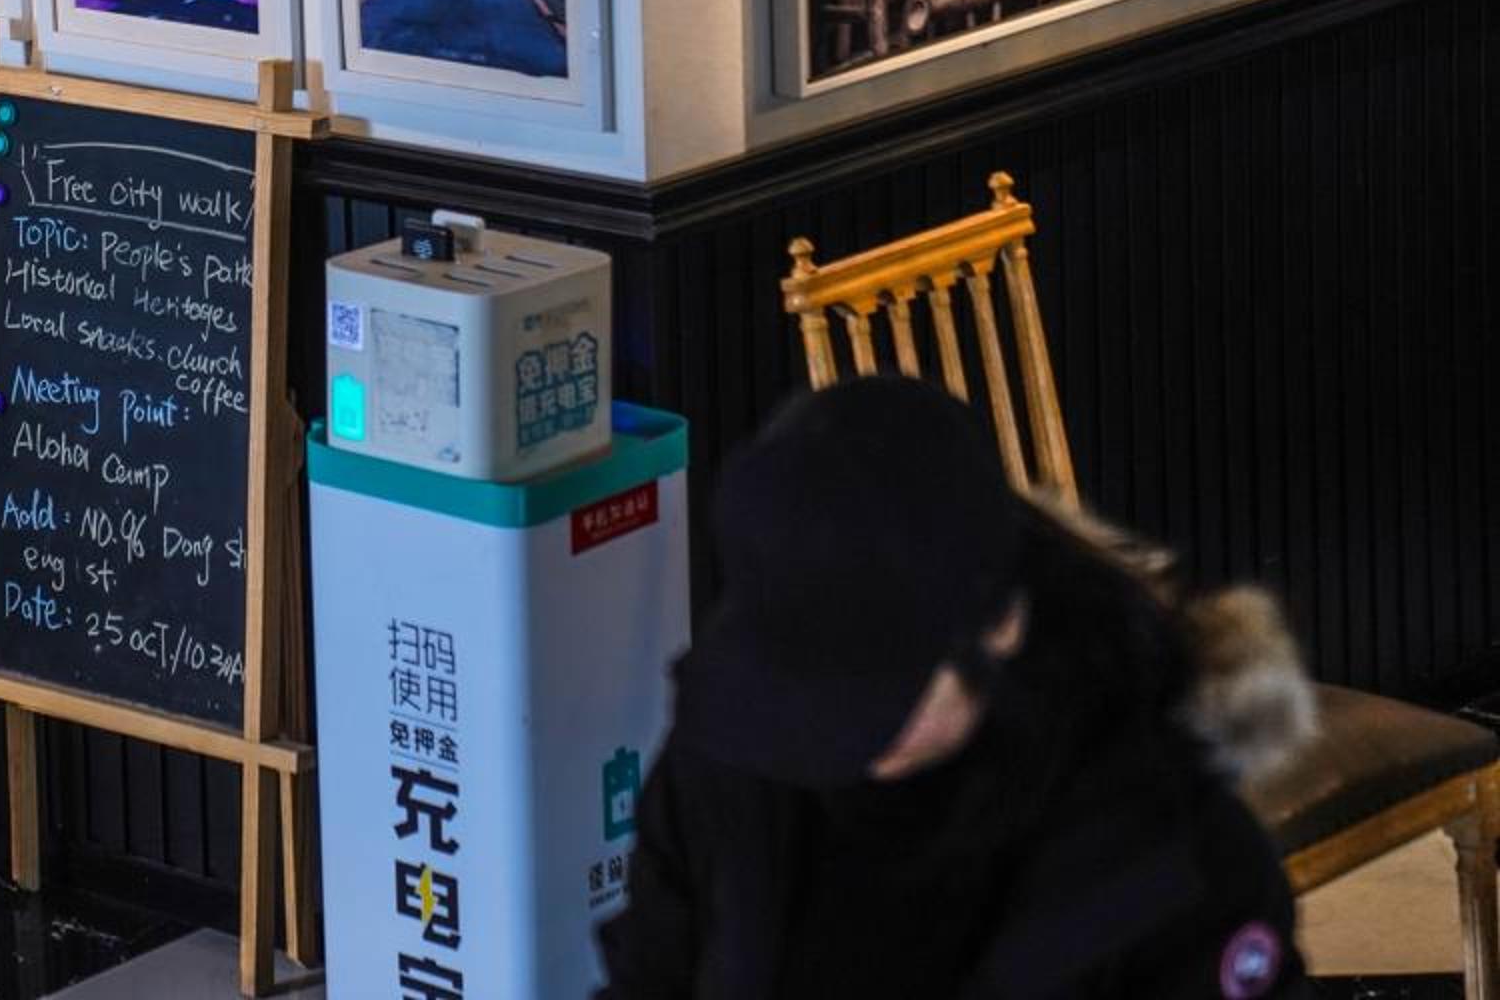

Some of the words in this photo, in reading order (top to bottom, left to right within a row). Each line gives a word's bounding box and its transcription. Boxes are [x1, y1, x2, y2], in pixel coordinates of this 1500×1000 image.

[46, 159, 97, 204] Free
[110, 177, 164, 231] city
[179, 190, 242, 225] walk
[12, 216, 89, 259] Topic:
[100, 230, 193, 282] People's
[176, 373, 249, 416] coffee
[163, 525, 214, 587] Dong
[387, 617, 456, 675] 扫码
[388, 667, 458, 722] 使用
[389, 720, 460, 764] 免押金
